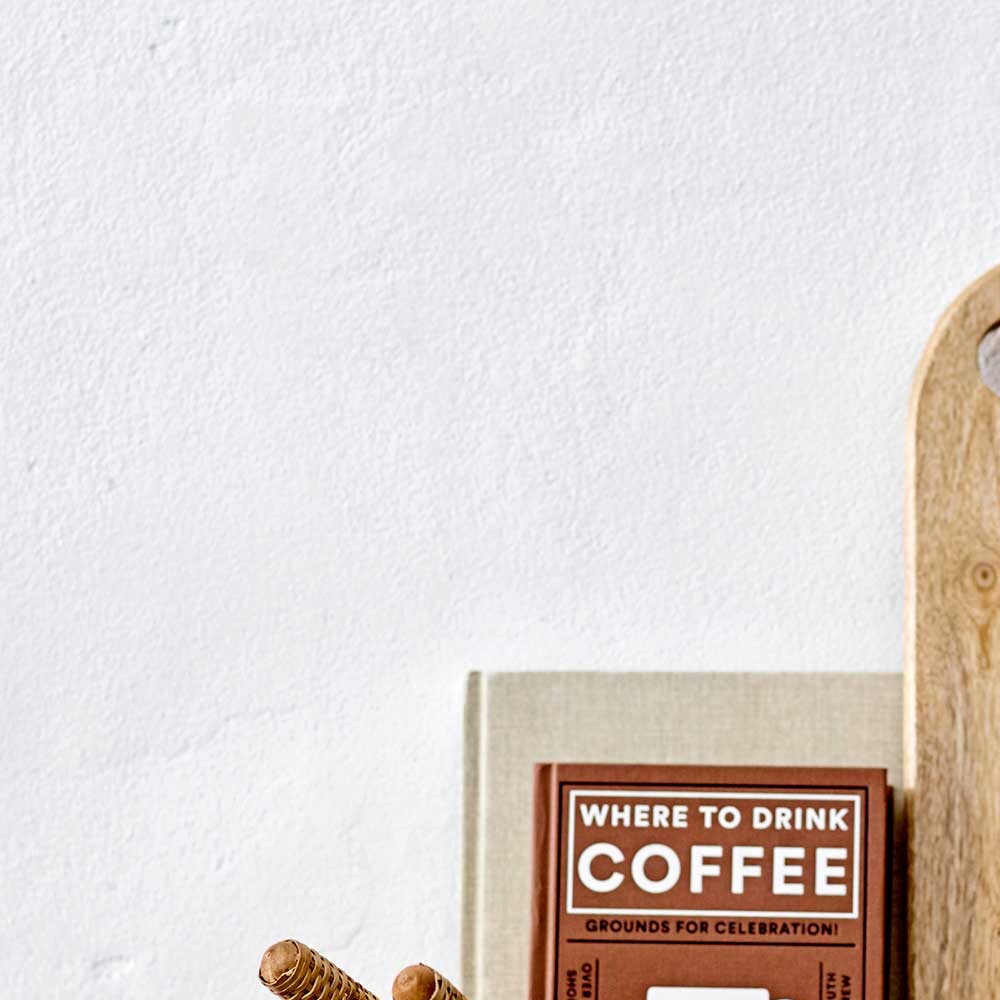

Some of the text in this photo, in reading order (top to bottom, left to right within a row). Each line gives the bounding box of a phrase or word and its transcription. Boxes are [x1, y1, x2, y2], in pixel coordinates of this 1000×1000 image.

[579, 803, 849, 831] WHERE TO DRINK
[577, 842, 849, 897] COFFEE
[585, 919, 839, 936] GROUNDS FOR CELEBRATION!
[581, 962, 592, 998] OVER
